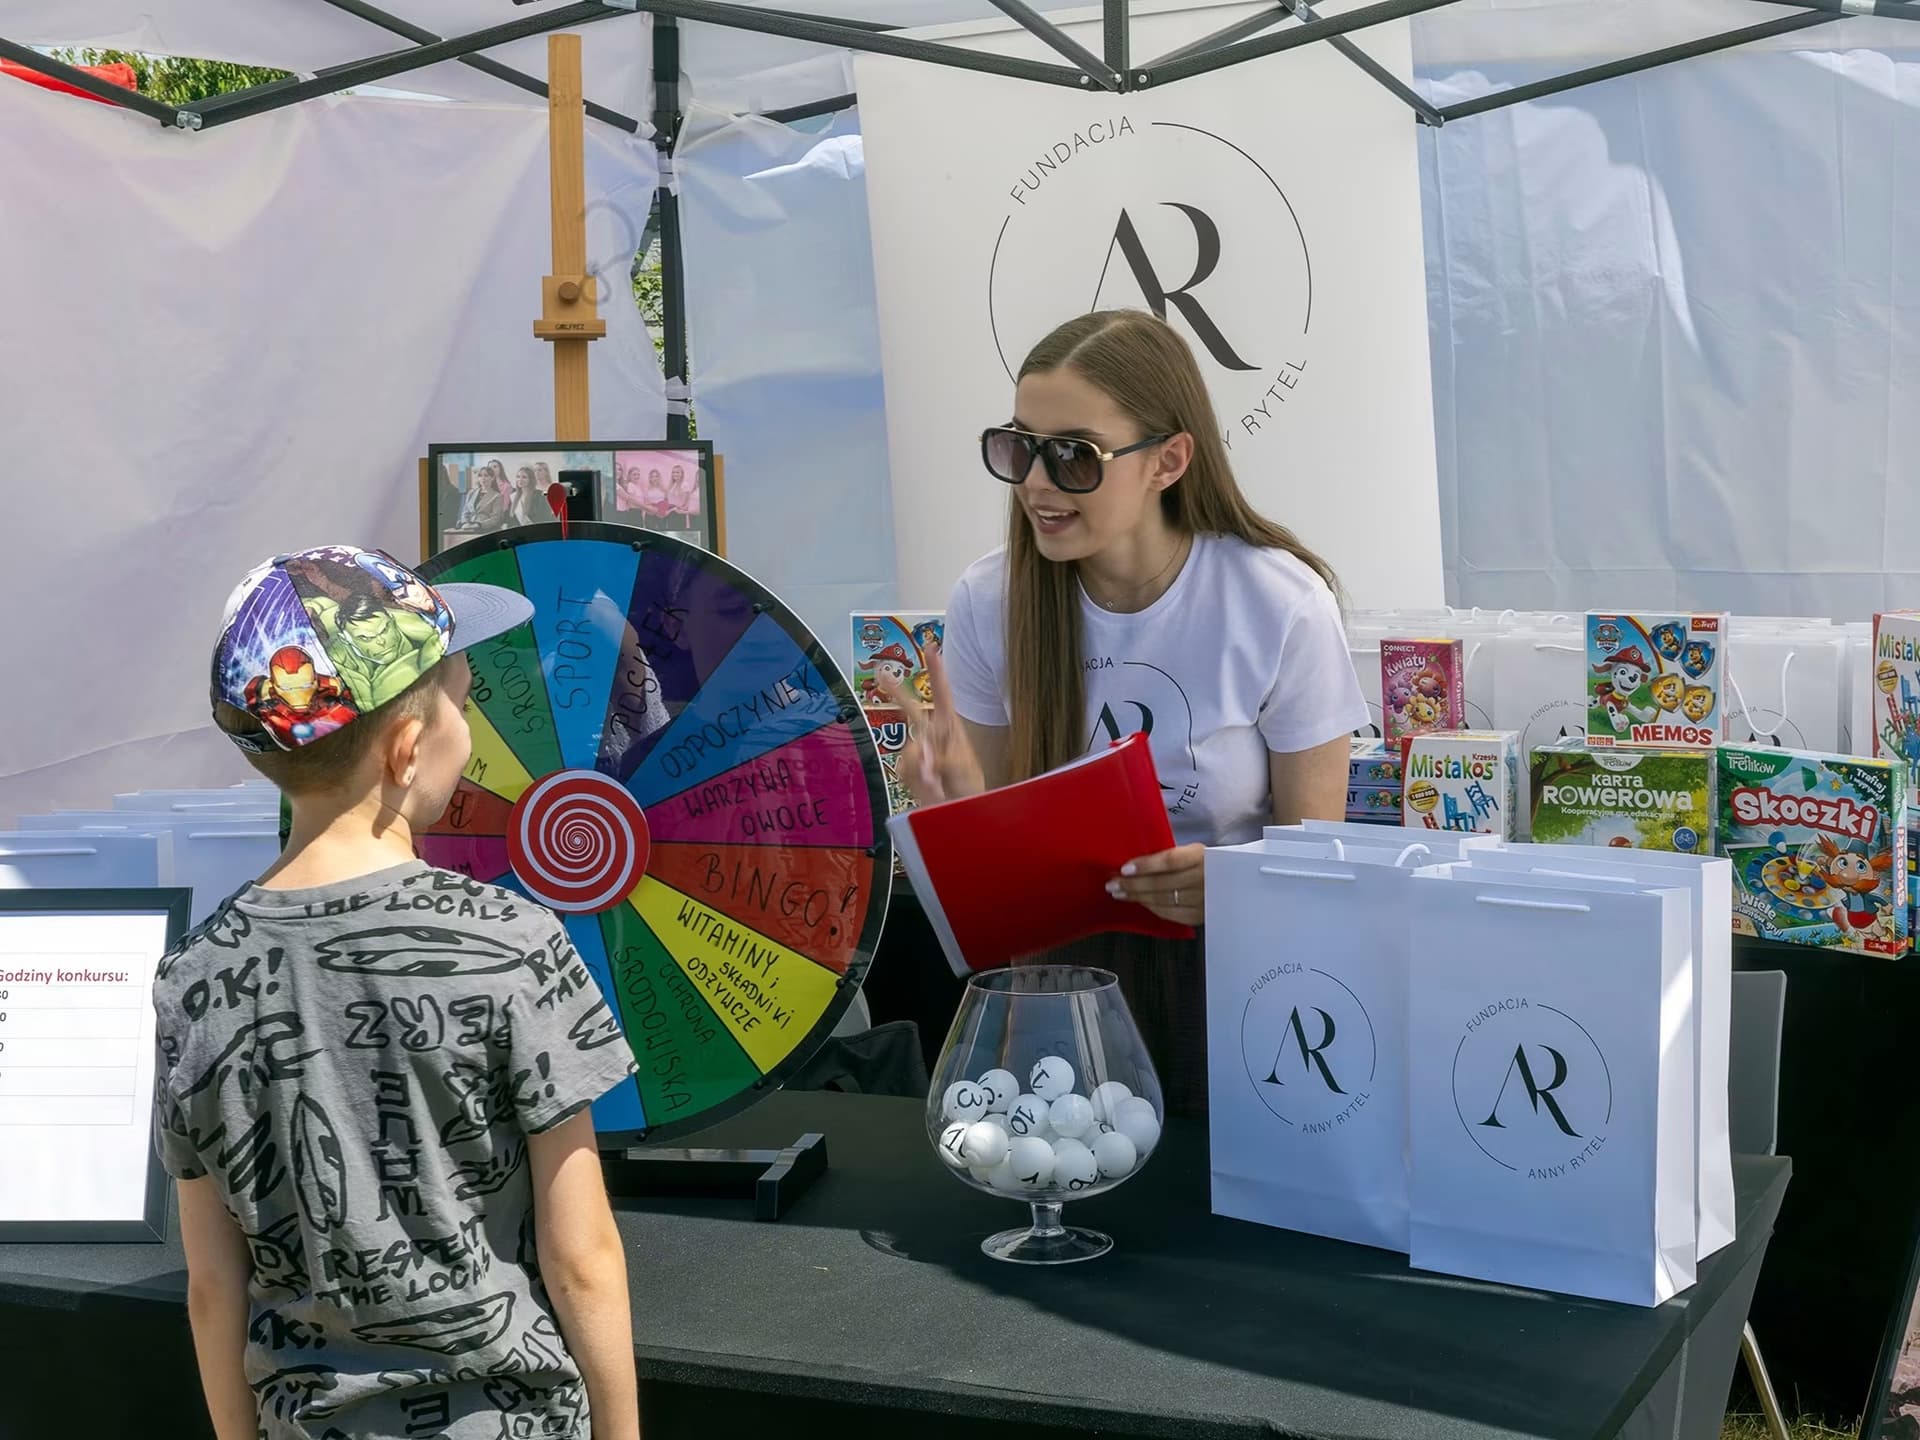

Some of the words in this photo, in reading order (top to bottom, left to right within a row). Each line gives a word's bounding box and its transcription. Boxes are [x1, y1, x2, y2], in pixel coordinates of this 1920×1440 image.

[1009, 115, 1135, 205] FUNDACJA
[1240, 359, 1307, 435] RYTEL
[554, 585, 593, 709] SPORT
[1082, 656, 1114, 673] ACJA
[1385, 654, 1426, 677] Kwiaty
[659, 663, 821, 779] ODPOCZYNEK
[1631, 724, 1713, 746] MEMOS
[683, 758, 792, 818] WARZYWA
[1411, 753, 1494, 781] Mistakos
[741, 798, 828, 837] OWOCE
[1733, 791, 1875, 839] Skoczki
[384, 891, 519, 922] LOCALS
[56, 968, 129, 983] konkursu:
[1250, 962, 1303, 996] FUNDACJA
[1466, 997, 1529, 1034] FUNDACJA
[1261, 1004, 1350, 1095] AR
[1476, 1042, 1584, 1139] AR
[1302, 1118, 1335, 1135] ANNY
[1336, 1089, 1371, 1126] RYTEL
[1527, 1163, 1568, 1181] ANNY
[1570, 1134, 1607, 1170] RYTEL
[315, 1284, 393, 1309] THE
